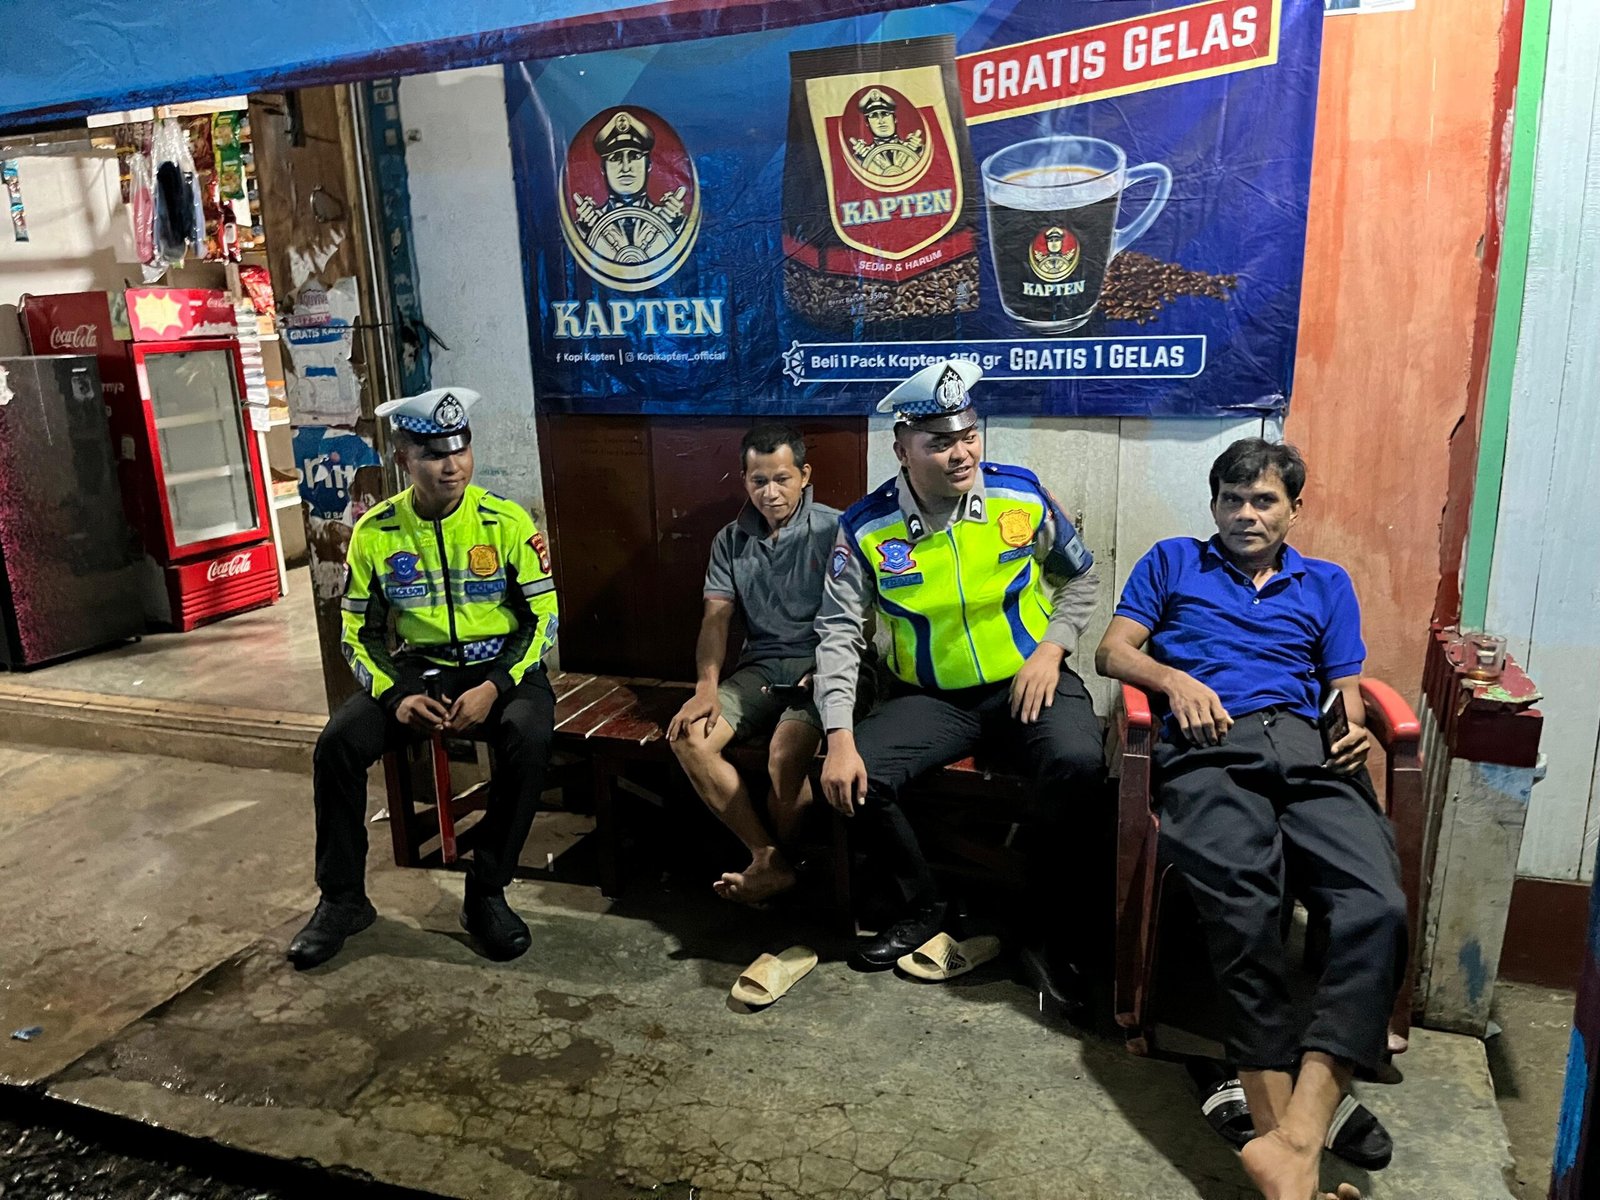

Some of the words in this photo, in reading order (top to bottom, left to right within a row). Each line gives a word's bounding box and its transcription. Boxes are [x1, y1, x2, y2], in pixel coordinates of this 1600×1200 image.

[971, 40, 1107, 104] GRATIS
[1122, 5, 1258, 72] GELAS
[841, 188, 952, 226] KAPTEN
[859, 260, 893, 272] SEDAP
[894, 263, 903, 272] &
[905, 249, 943, 270] HARUM
[1022, 280, 1086, 297] KAPTEN
[551, 298, 724, 339] KAPTEN
[290, 328, 320, 340] GRATIS
[563, 352, 583, 362] Kopi
[584, 352, 615, 362] Kapten
[637, 351, 727, 363] Kopikapten_official
[811, 354, 838, 368] Beli
[841, 354, 848, 367] 1
[850, 353, 885, 368] Pack
[888, 353, 946, 371] Kapten
[983, 354, 1003, 371] gr
[1009, 347, 1087, 371] GRATIS
[1094, 345, 1103, 369] 1
[1109, 344, 1185, 369] GELAS
